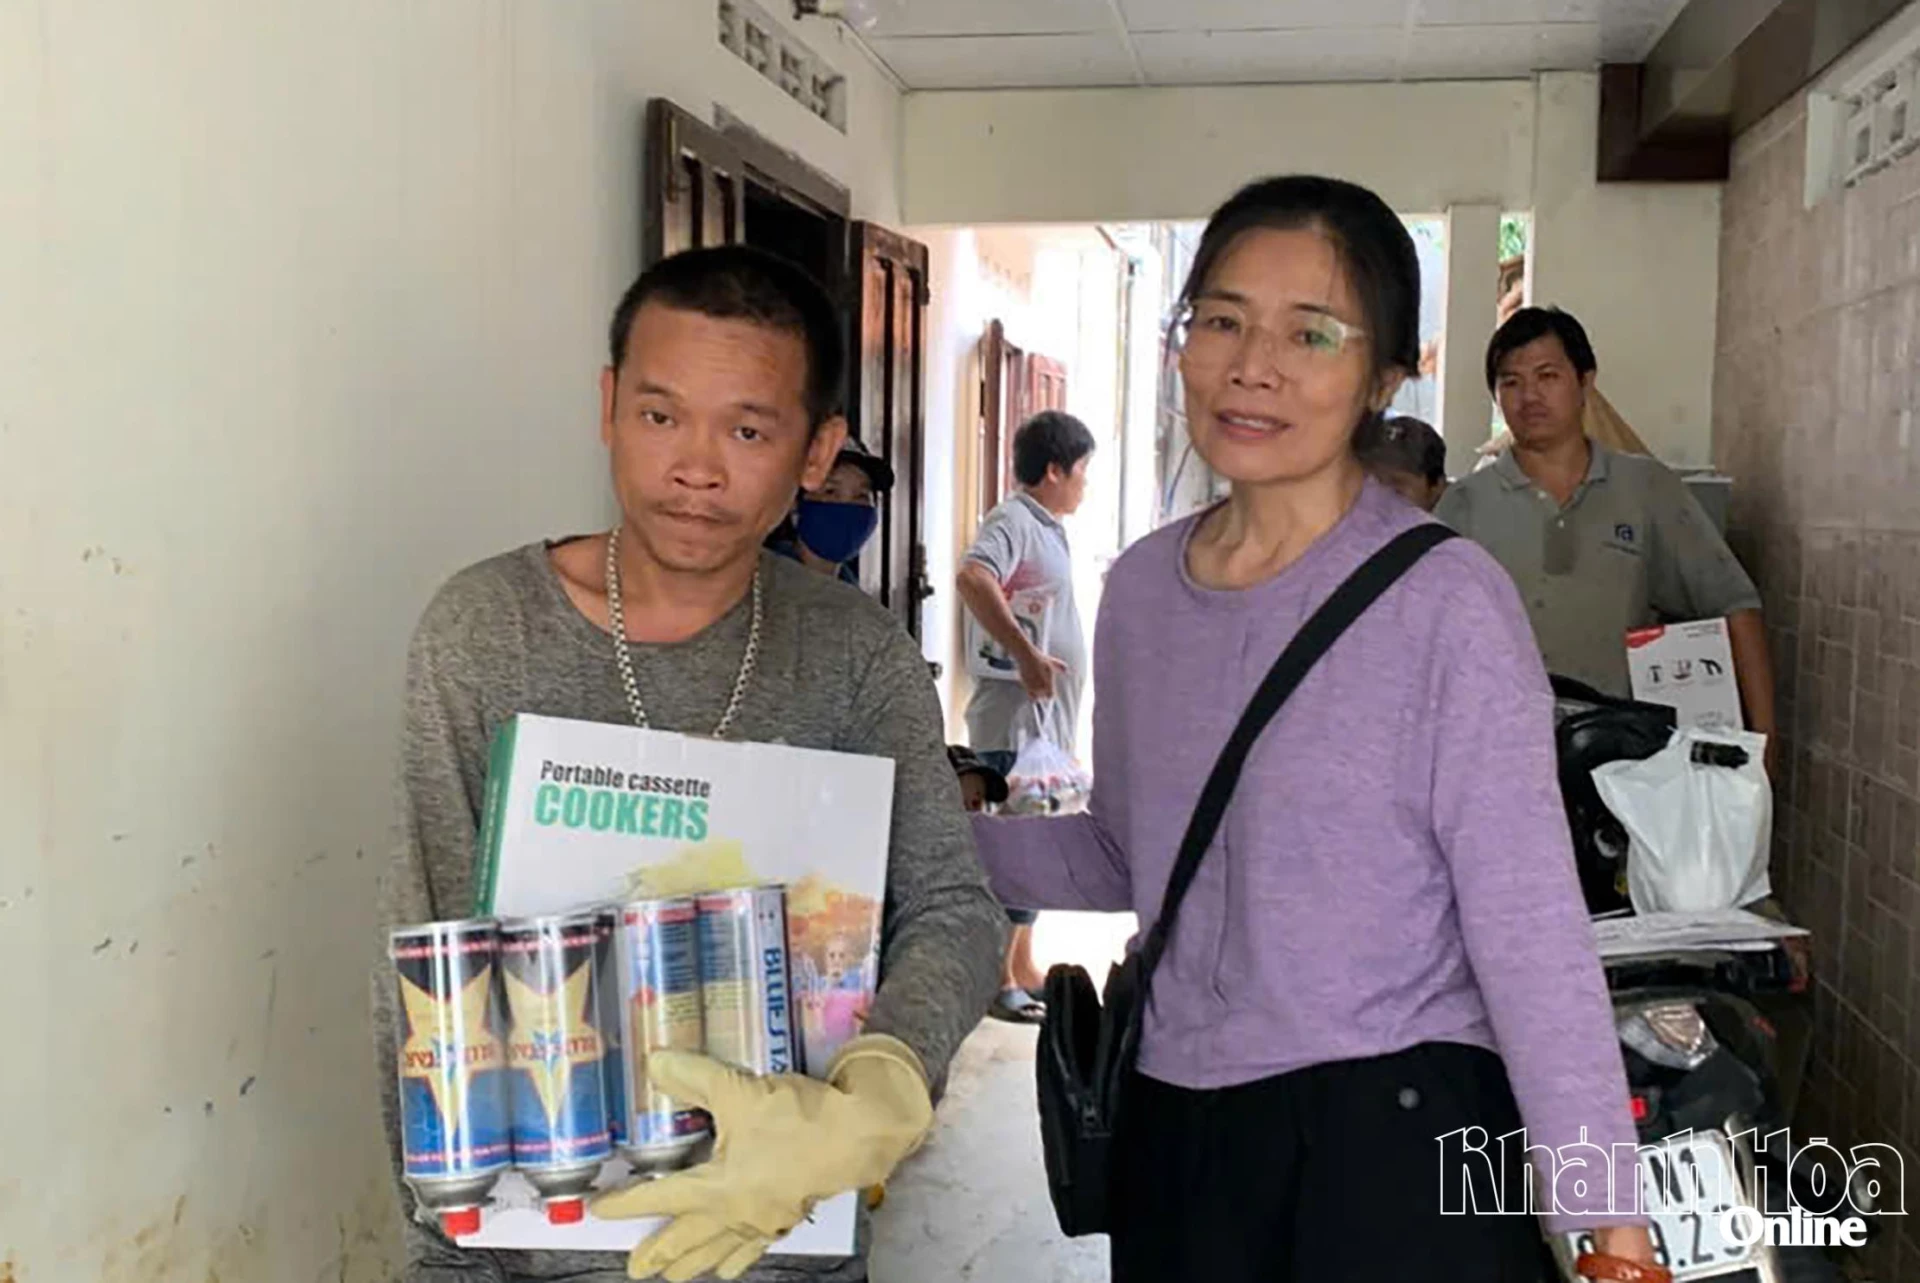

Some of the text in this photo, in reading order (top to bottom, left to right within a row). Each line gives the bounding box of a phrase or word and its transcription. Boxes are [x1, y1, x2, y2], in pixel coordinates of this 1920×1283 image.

[541, 760, 711, 798] Portable cassette
[534, 783, 709, 841] COOKERS
